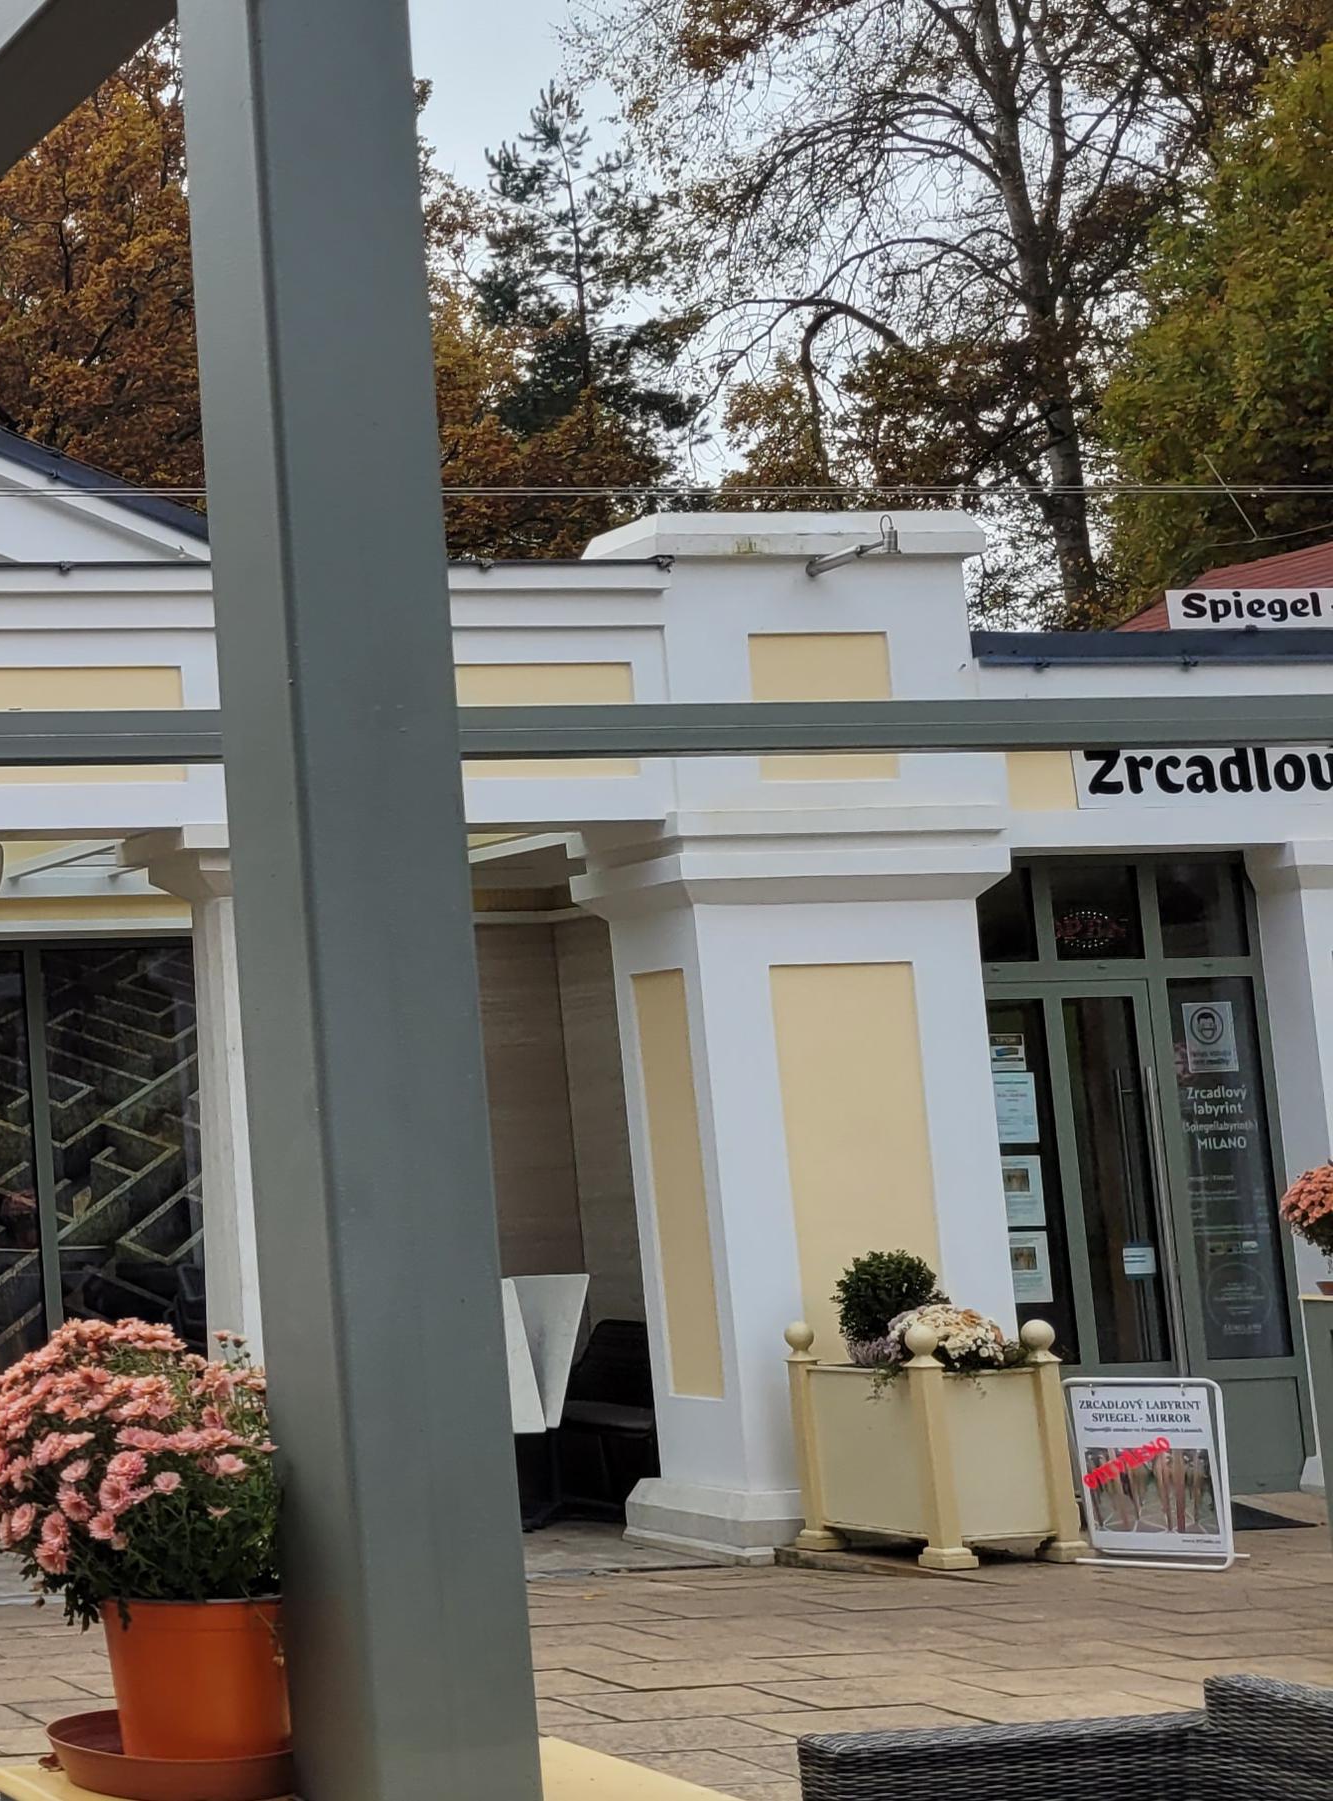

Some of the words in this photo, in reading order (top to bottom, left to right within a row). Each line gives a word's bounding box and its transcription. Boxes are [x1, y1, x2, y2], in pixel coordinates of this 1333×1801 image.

[1180, 591, 1323, 623] Spiegel
[1186, 1084, 1247, 1100] Zrcadlový
[1193, 1101, 1243, 1117] labyrint
[1197, 1136, 1247, 1151] MILANO
[1079, 1398, 1144, 1410] ZRCADLOVÝ
[1146, 1400, 1201, 1411] LABYRINT
[1091, 1413, 1139, 1423] SPIEGEL
[1145, 1413, 1191, 1423] MIRROR
